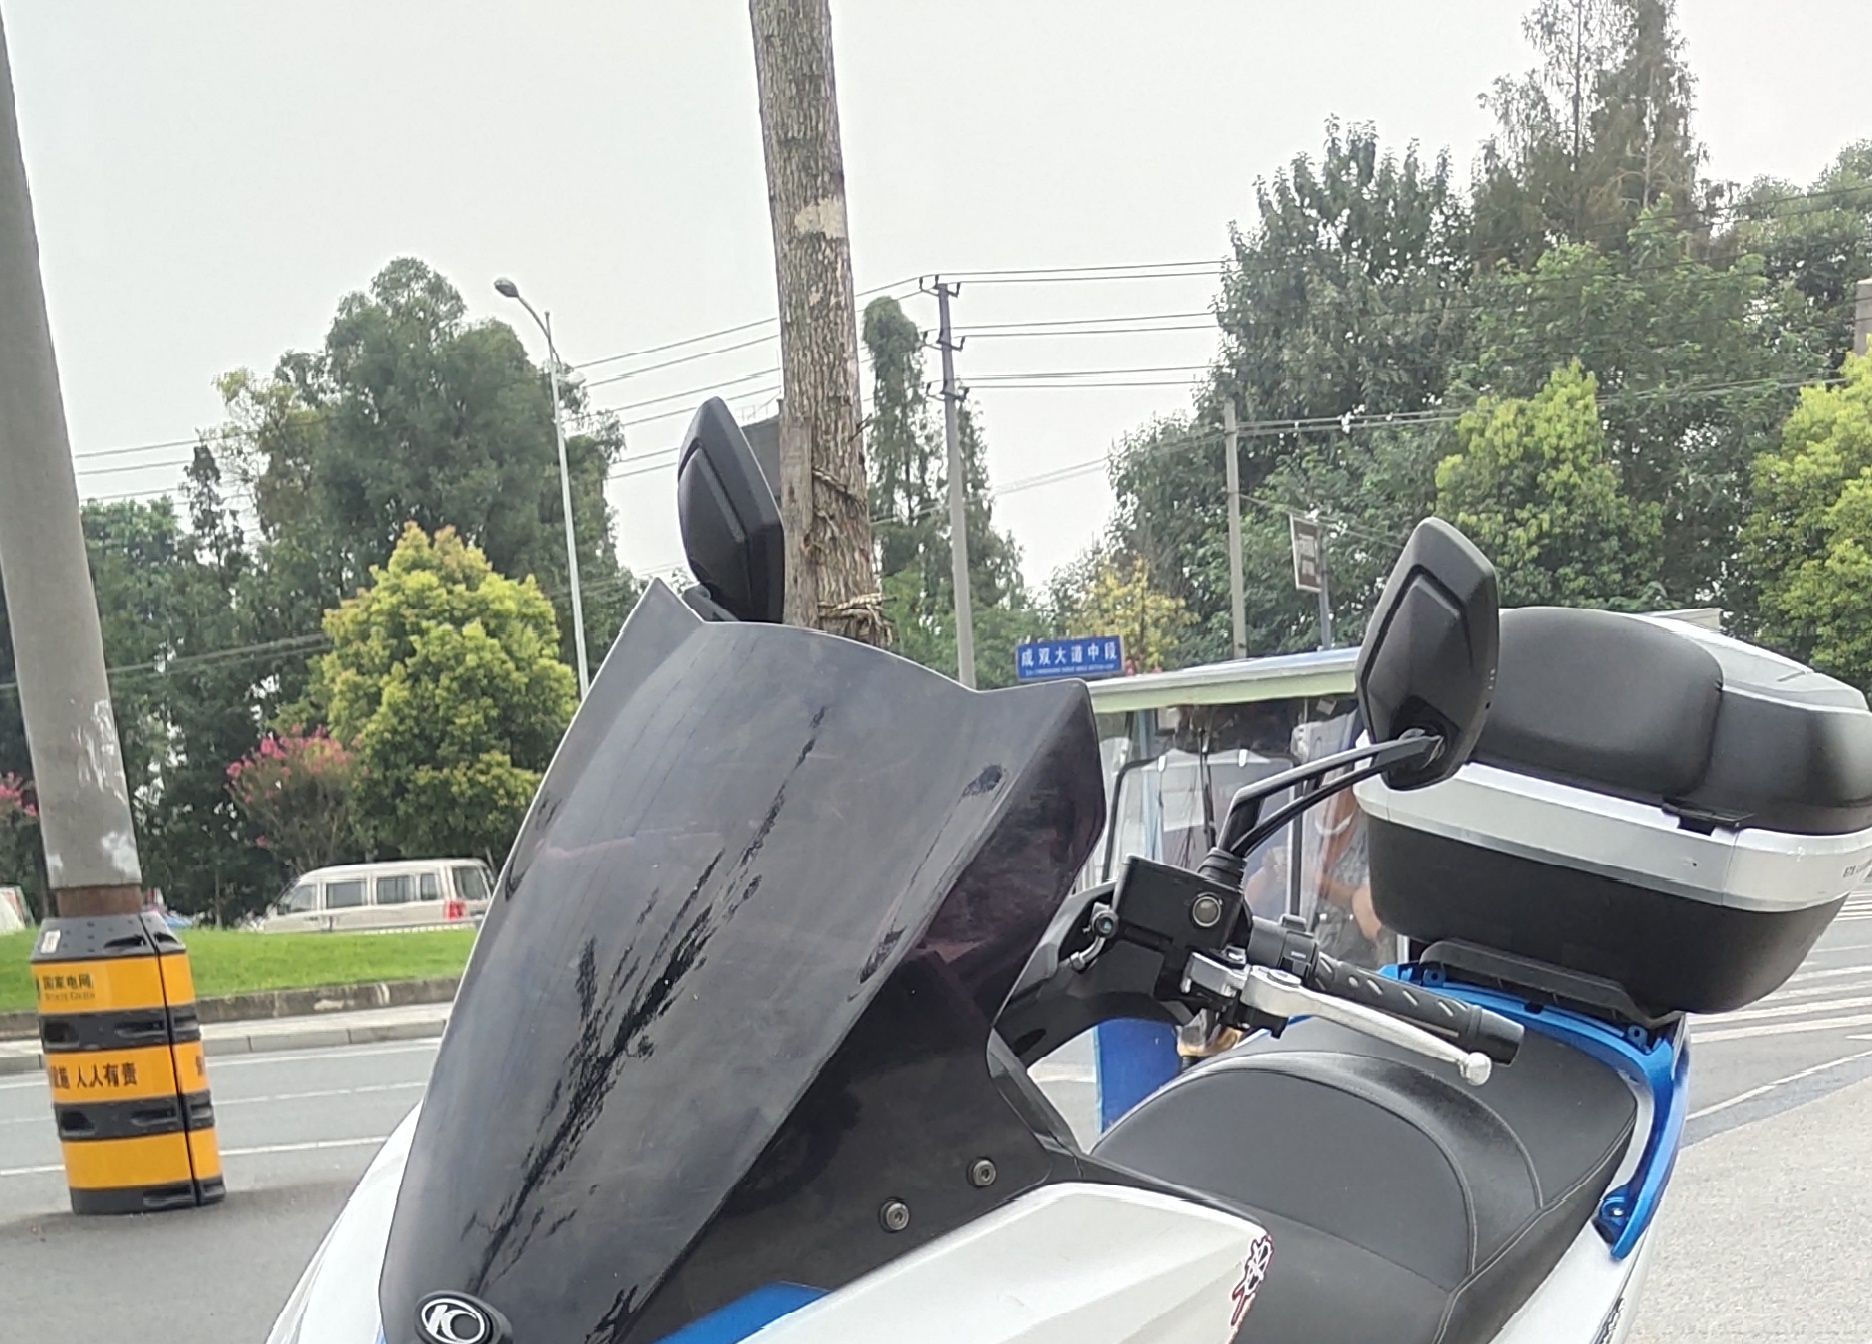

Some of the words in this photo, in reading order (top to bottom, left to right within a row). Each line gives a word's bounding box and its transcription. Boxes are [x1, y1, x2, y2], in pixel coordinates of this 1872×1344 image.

[1021, 641, 1117, 668] 成双大道中段
[77, 1062, 138, 1088] 人人有责
